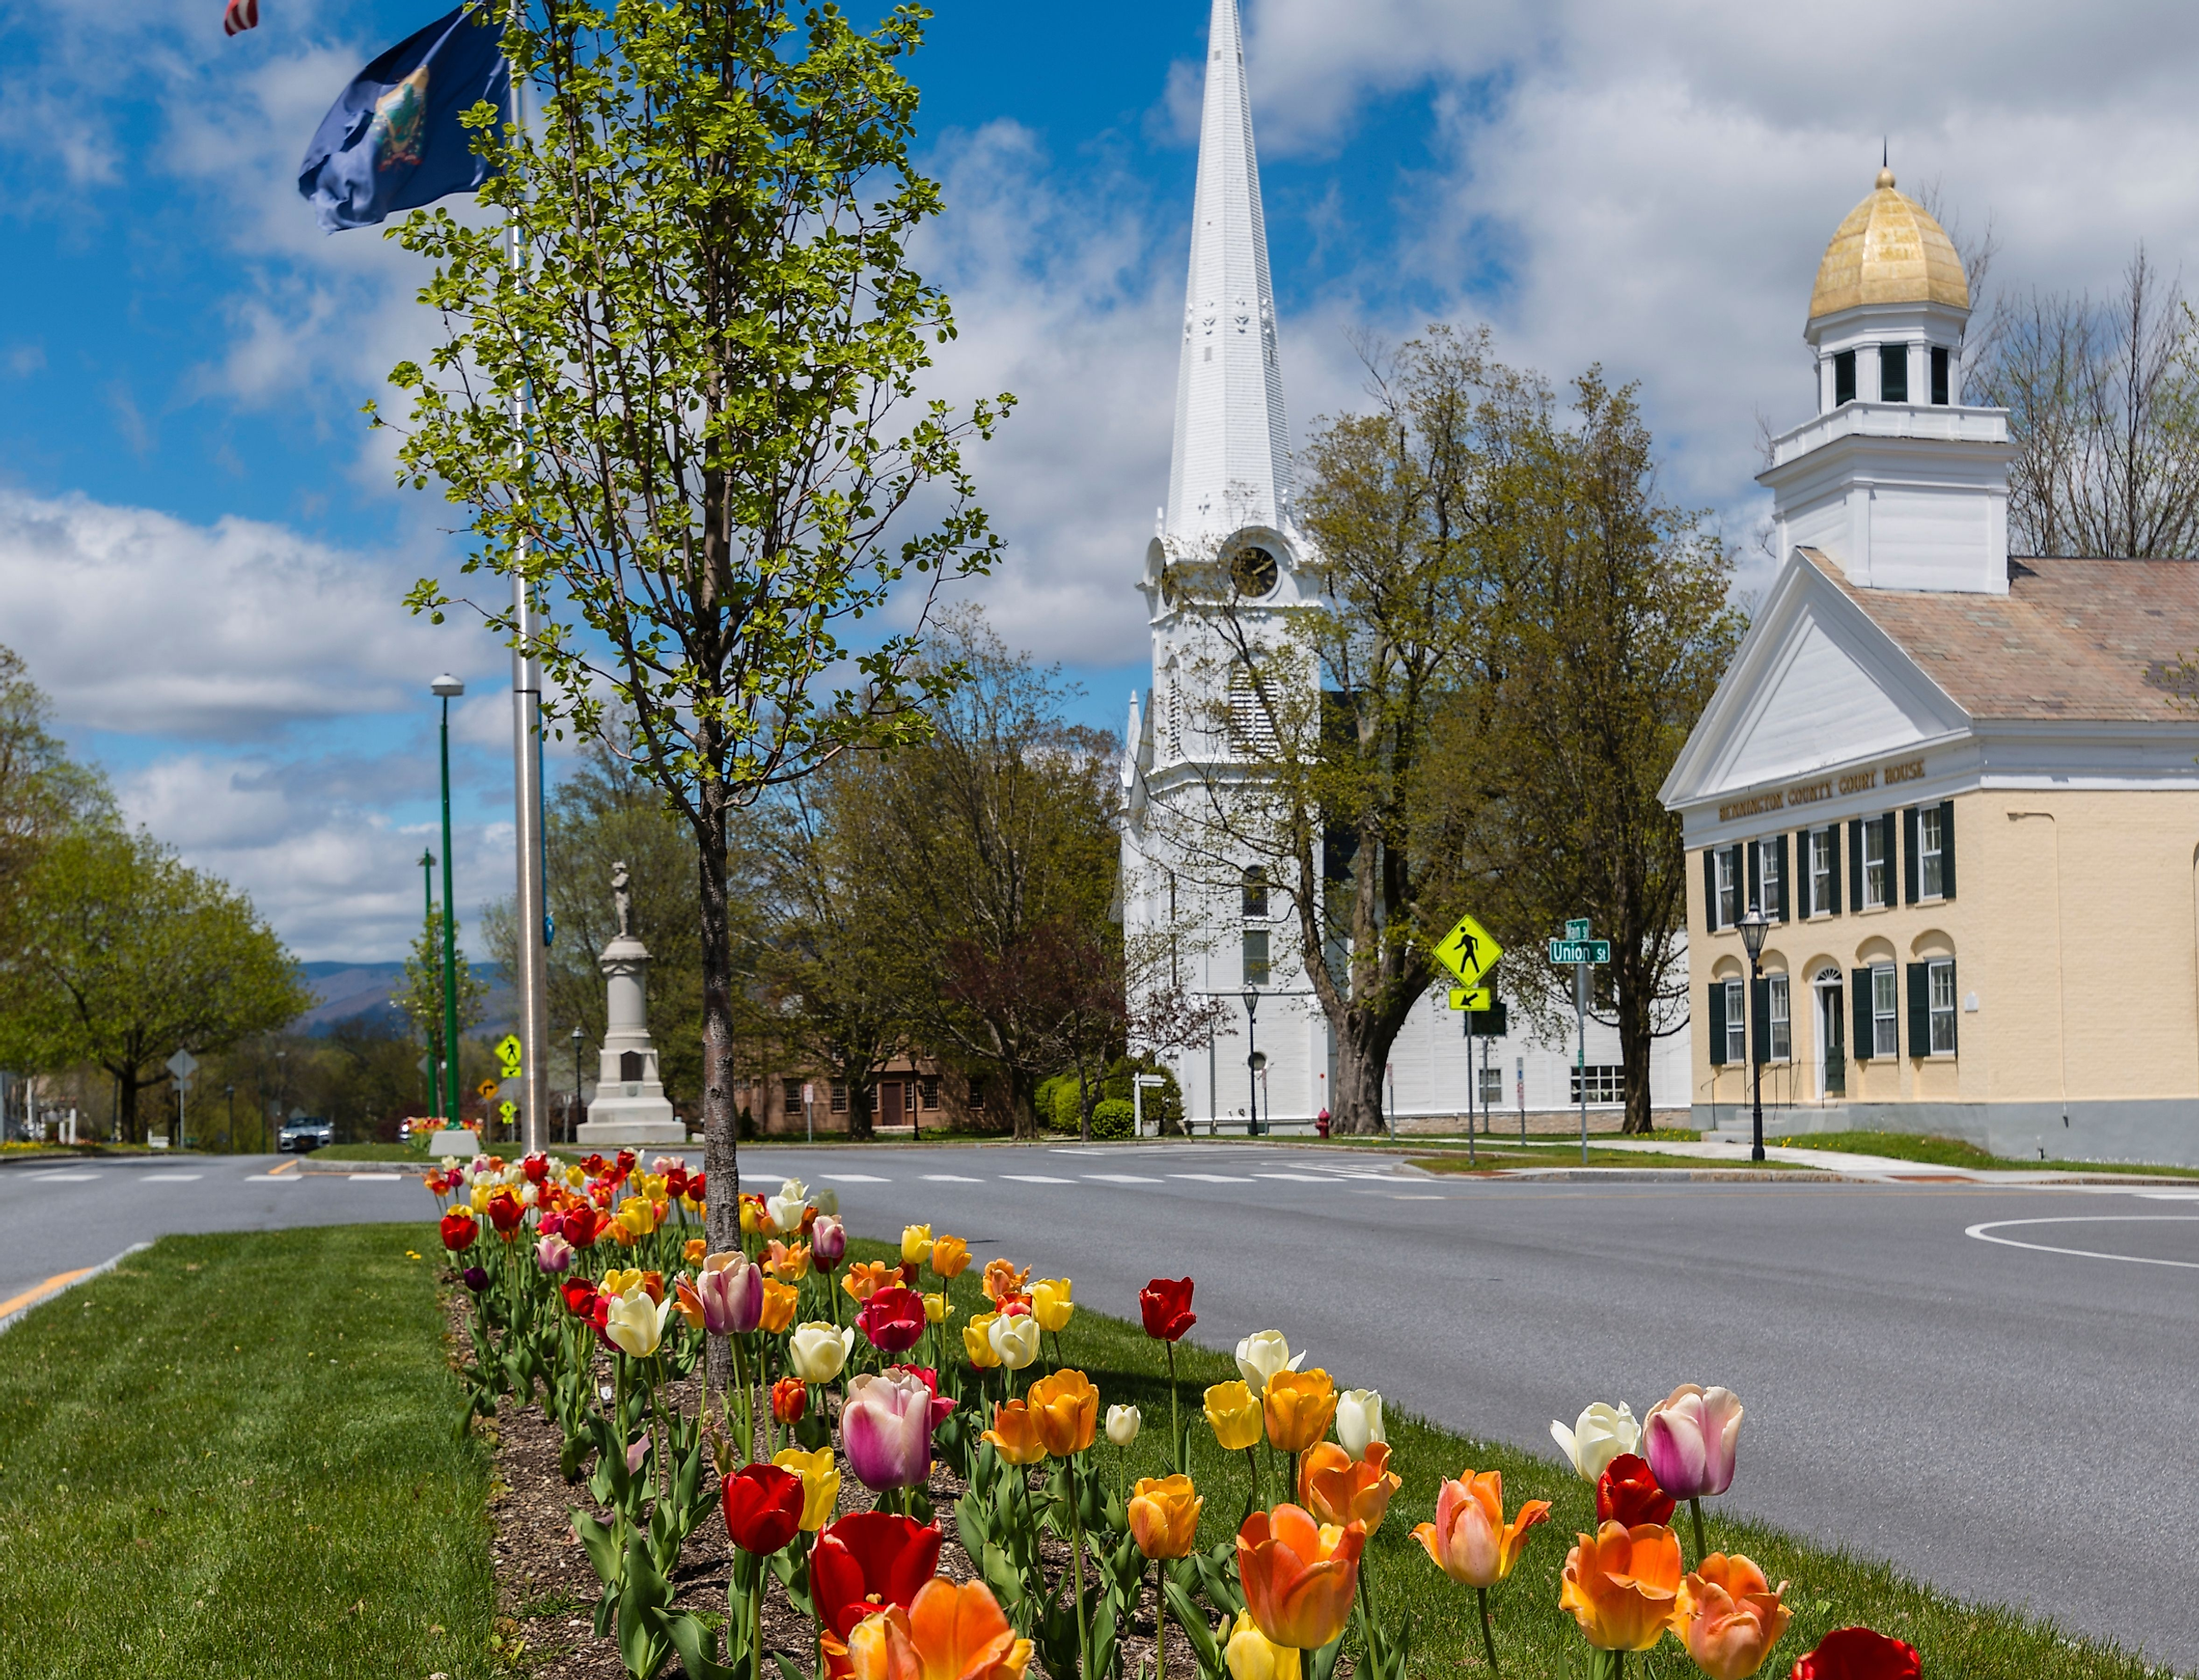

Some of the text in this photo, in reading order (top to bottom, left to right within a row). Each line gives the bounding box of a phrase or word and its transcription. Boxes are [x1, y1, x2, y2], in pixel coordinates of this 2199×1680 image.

[1719, 760, 1925, 821] BENNINGTON COUNTY COURT HOUSE
[1553, 943, 1589, 961] Union
